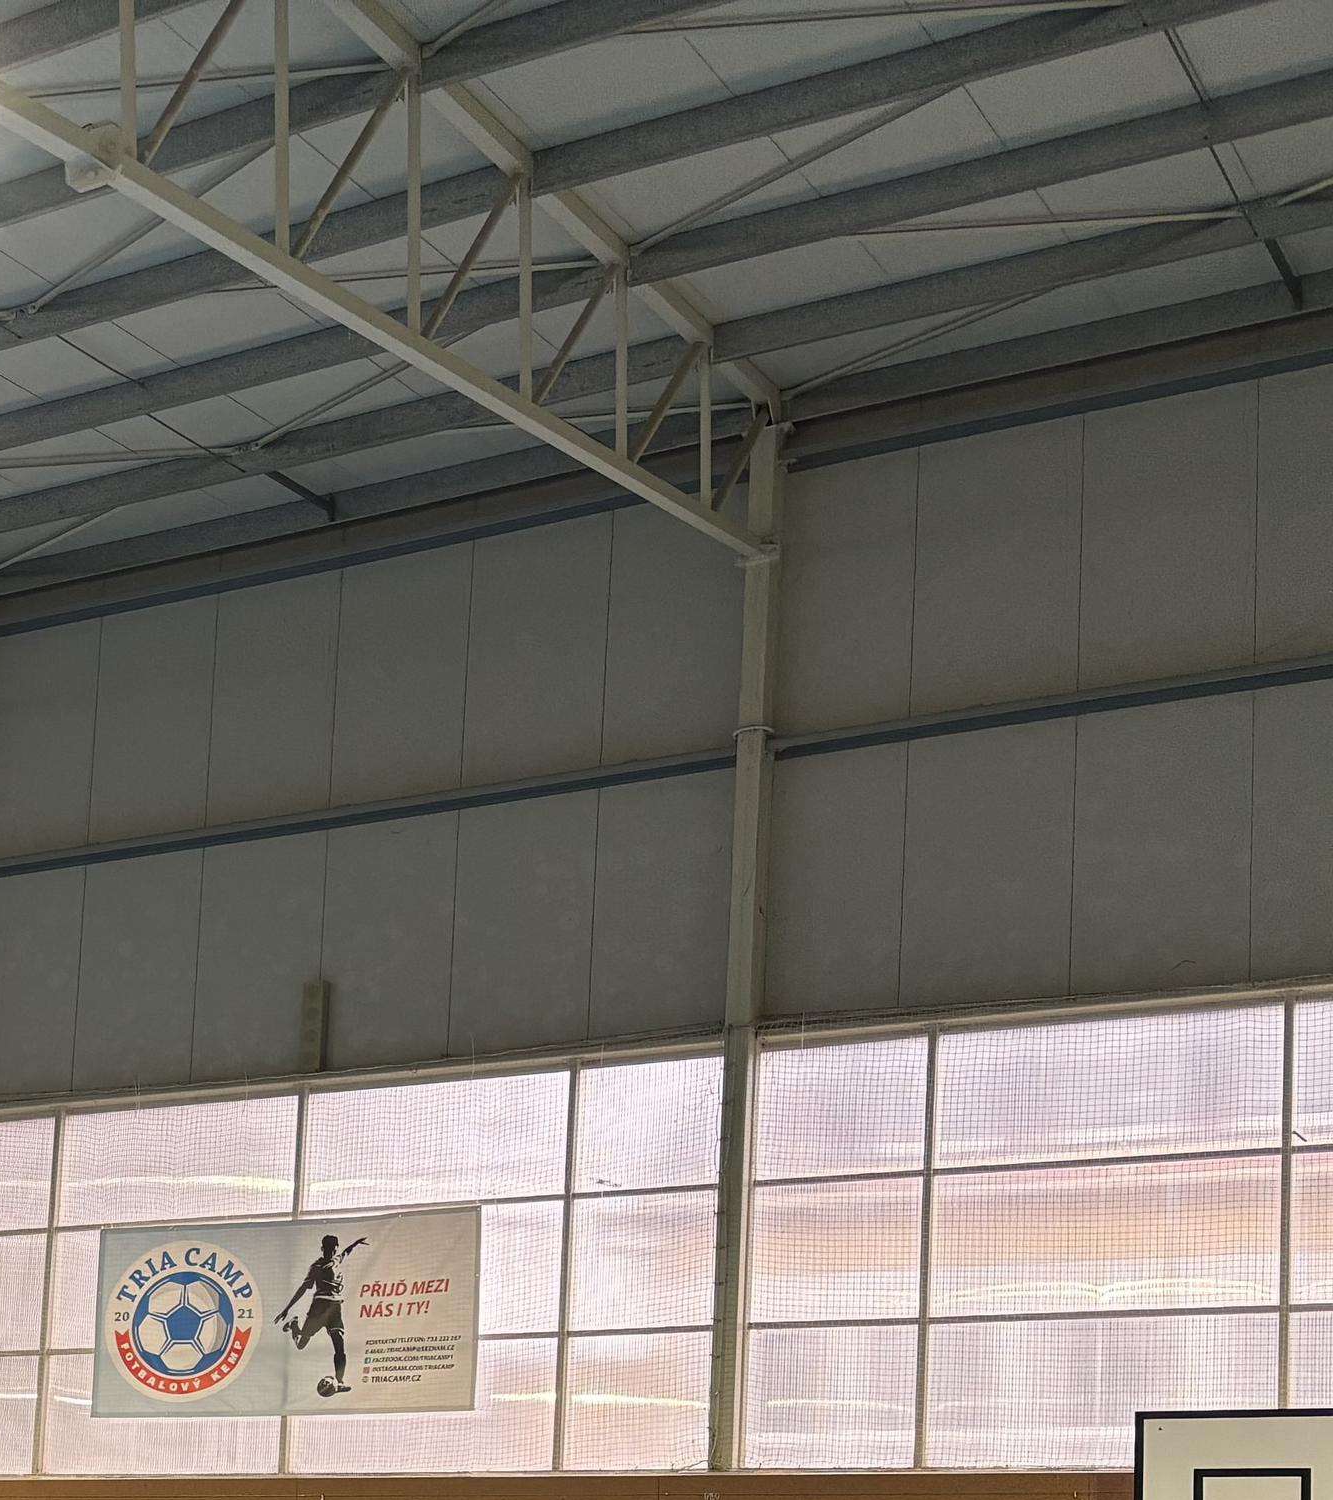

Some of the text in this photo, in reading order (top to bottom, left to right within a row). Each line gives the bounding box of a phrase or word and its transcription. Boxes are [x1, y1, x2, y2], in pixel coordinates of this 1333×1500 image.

[116, 1247, 254, 1304] TRIA CAMP
[360, 1278, 451, 1299] PŘIJĎ MEZI
[114, 1307, 254, 1323] 20 21
[360, 1301, 394, 1319] NÁS
[406, 1300, 430, 1316] TY!
[121, 1339, 244, 1394] FOTBALOVÝ KEMP
[371, 1374, 422, 1383] TRIACAMP.CZ
